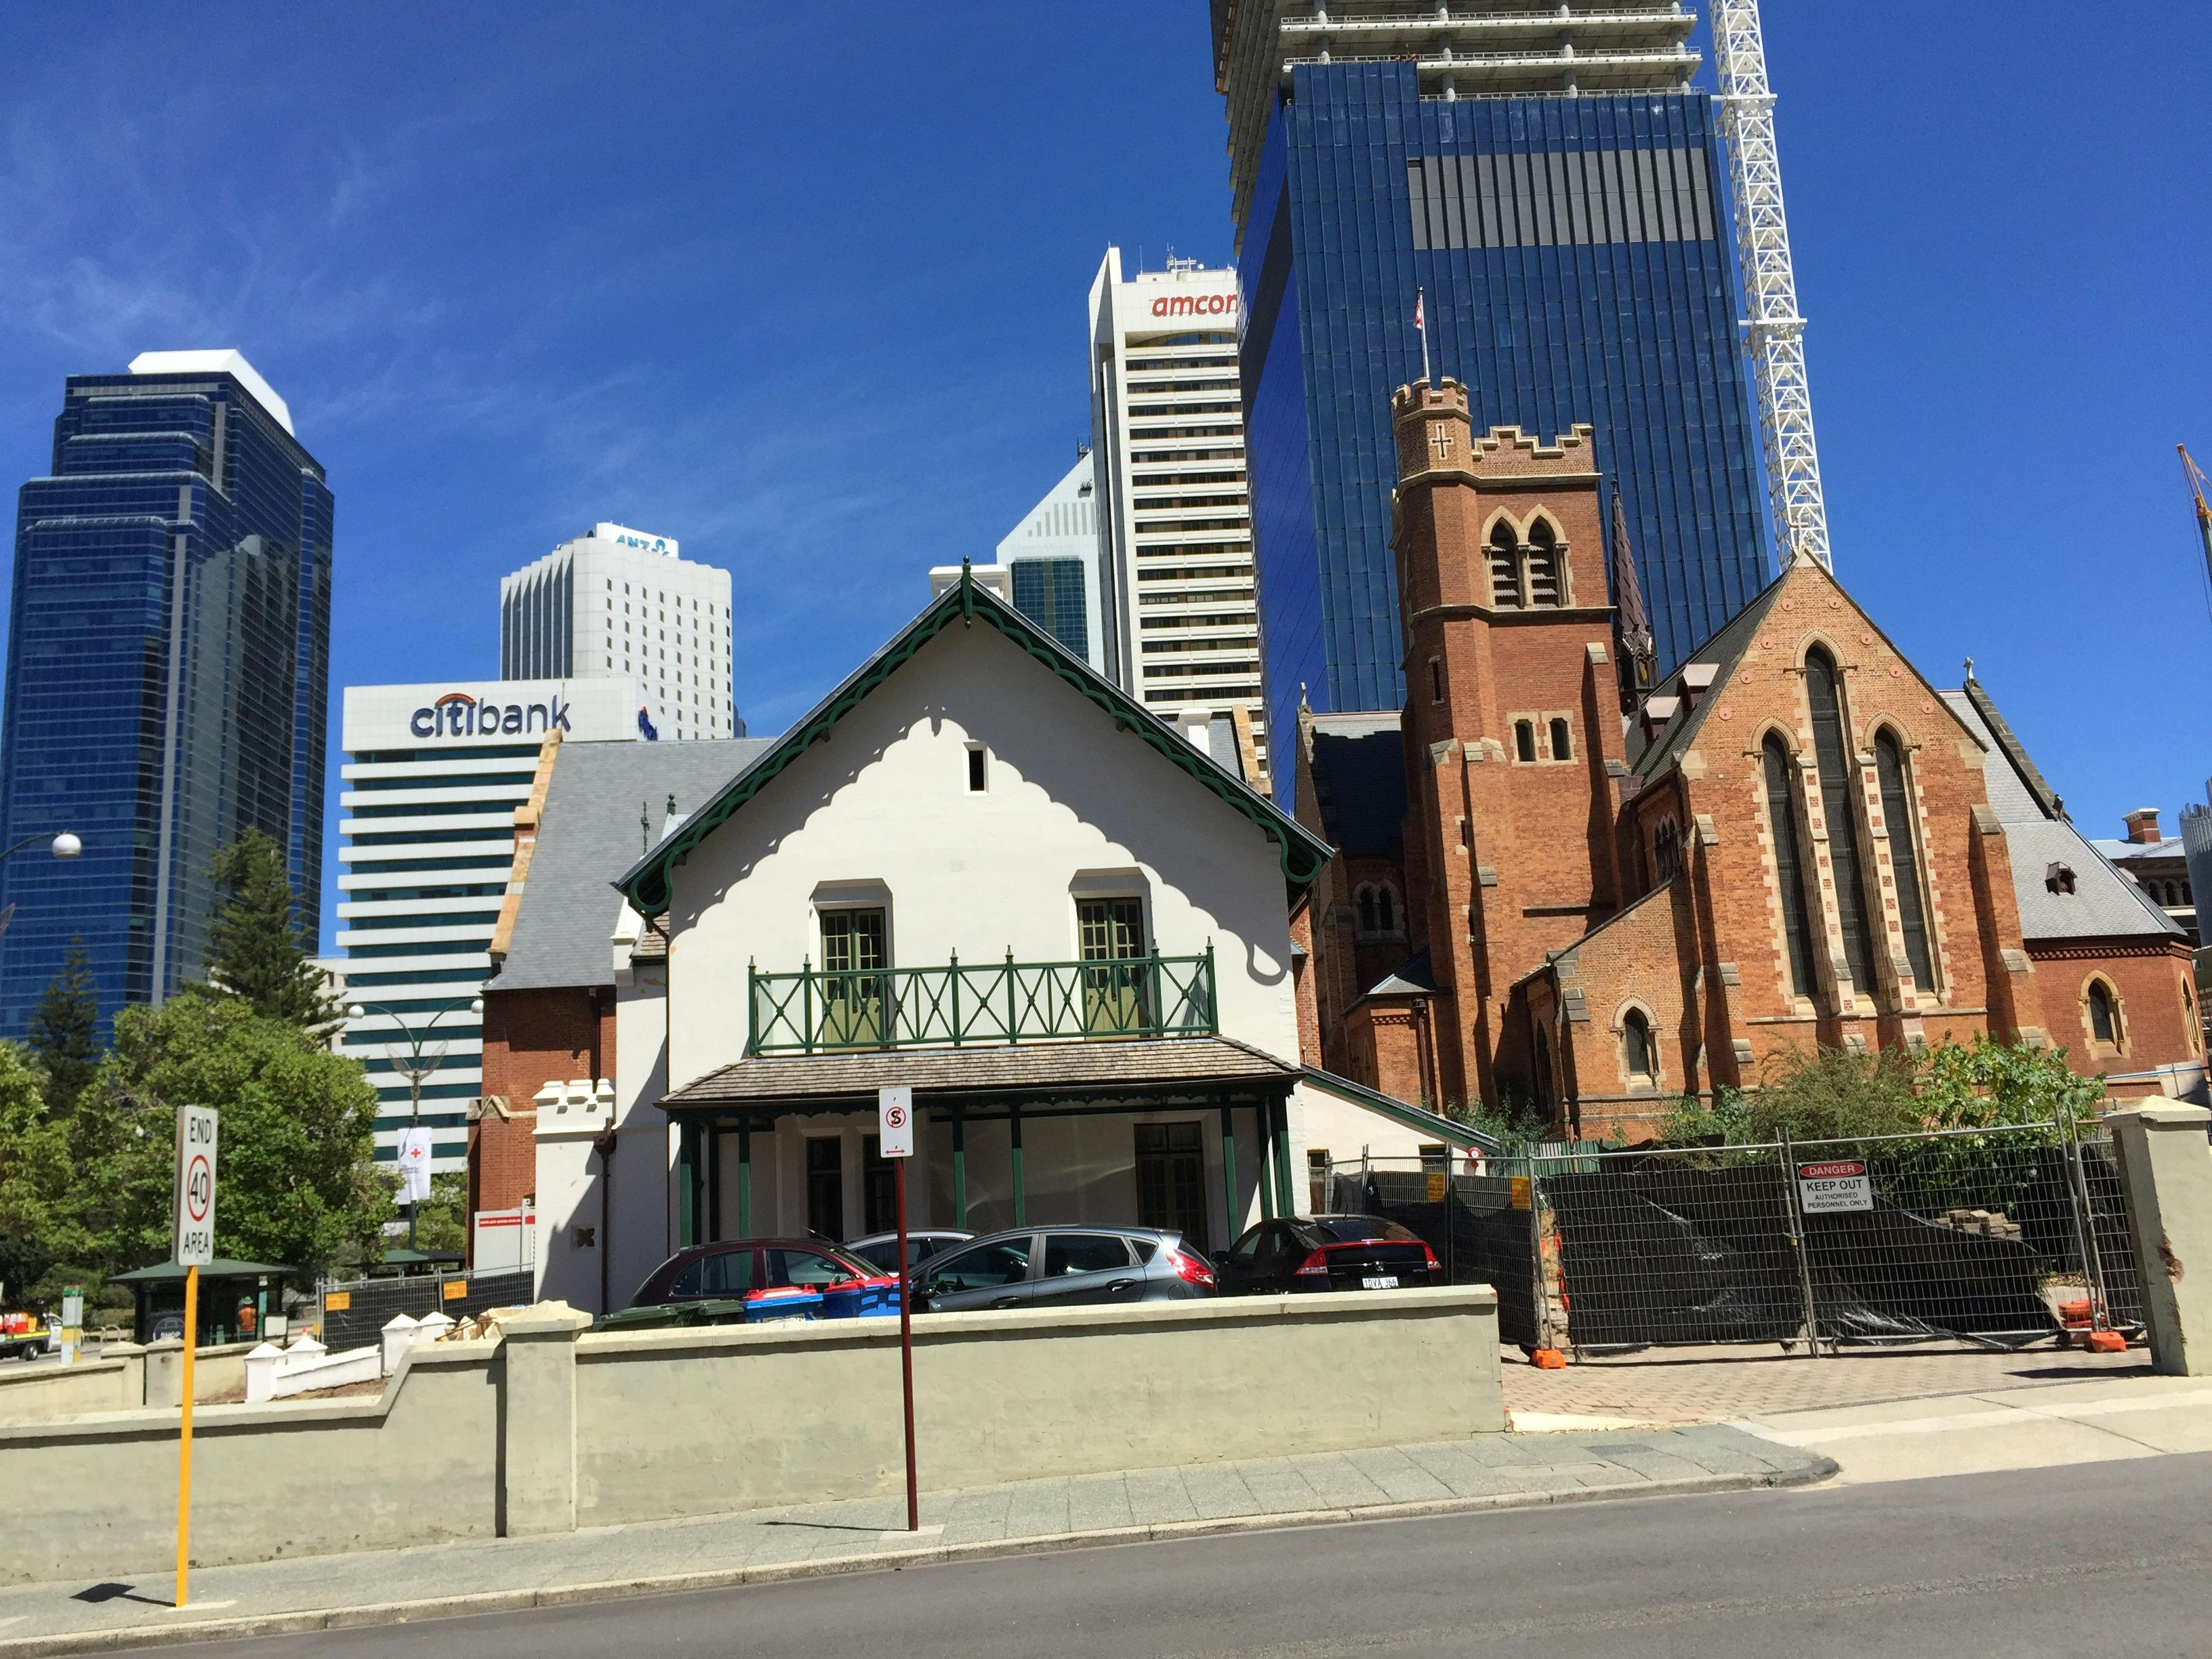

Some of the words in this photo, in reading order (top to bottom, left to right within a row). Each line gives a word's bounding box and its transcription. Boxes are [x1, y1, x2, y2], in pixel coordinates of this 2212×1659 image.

[411, 693, 571, 738] citibank
[190, 1117, 211, 1144] END
[1809, 1165, 1855, 1176] DANGER
[190, 1172, 209, 1204] 40
[1806, 1181, 1836, 1191] KEEP
[1839, 1179, 1862, 1190] OUT
[1815, 1192, 1858, 1200] AUTHORISED
[183, 1232, 209, 1254] AREA
